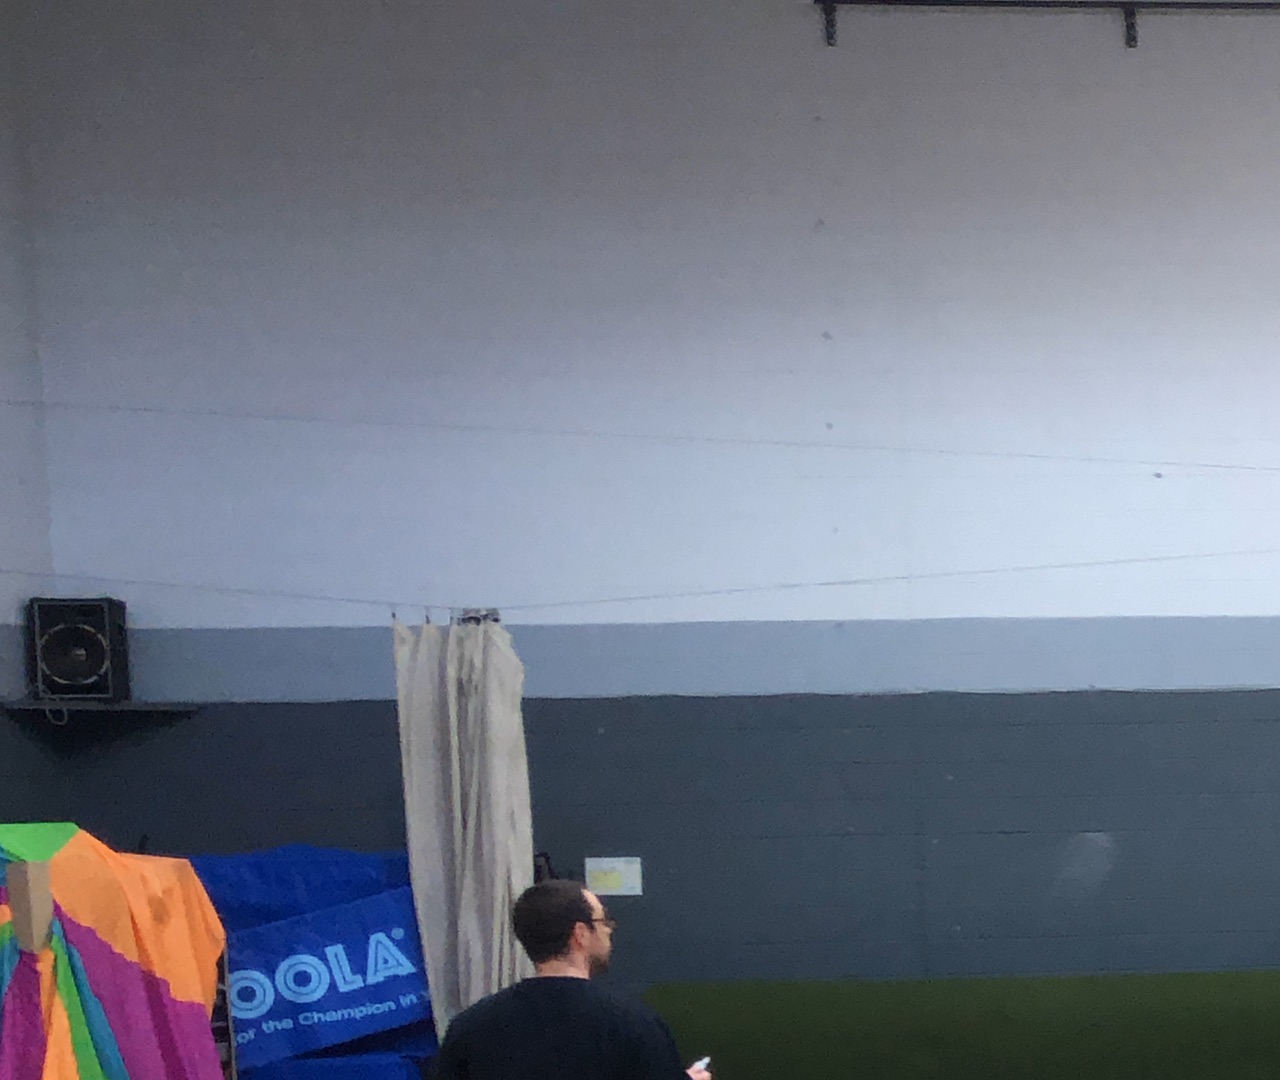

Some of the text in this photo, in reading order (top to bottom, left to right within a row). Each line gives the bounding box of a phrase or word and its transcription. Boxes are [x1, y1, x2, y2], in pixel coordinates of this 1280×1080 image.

[261, 1017, 294, 1034] the
[298, 1000, 397, 1026] Champion
[399, 993, 418, 1009] in
